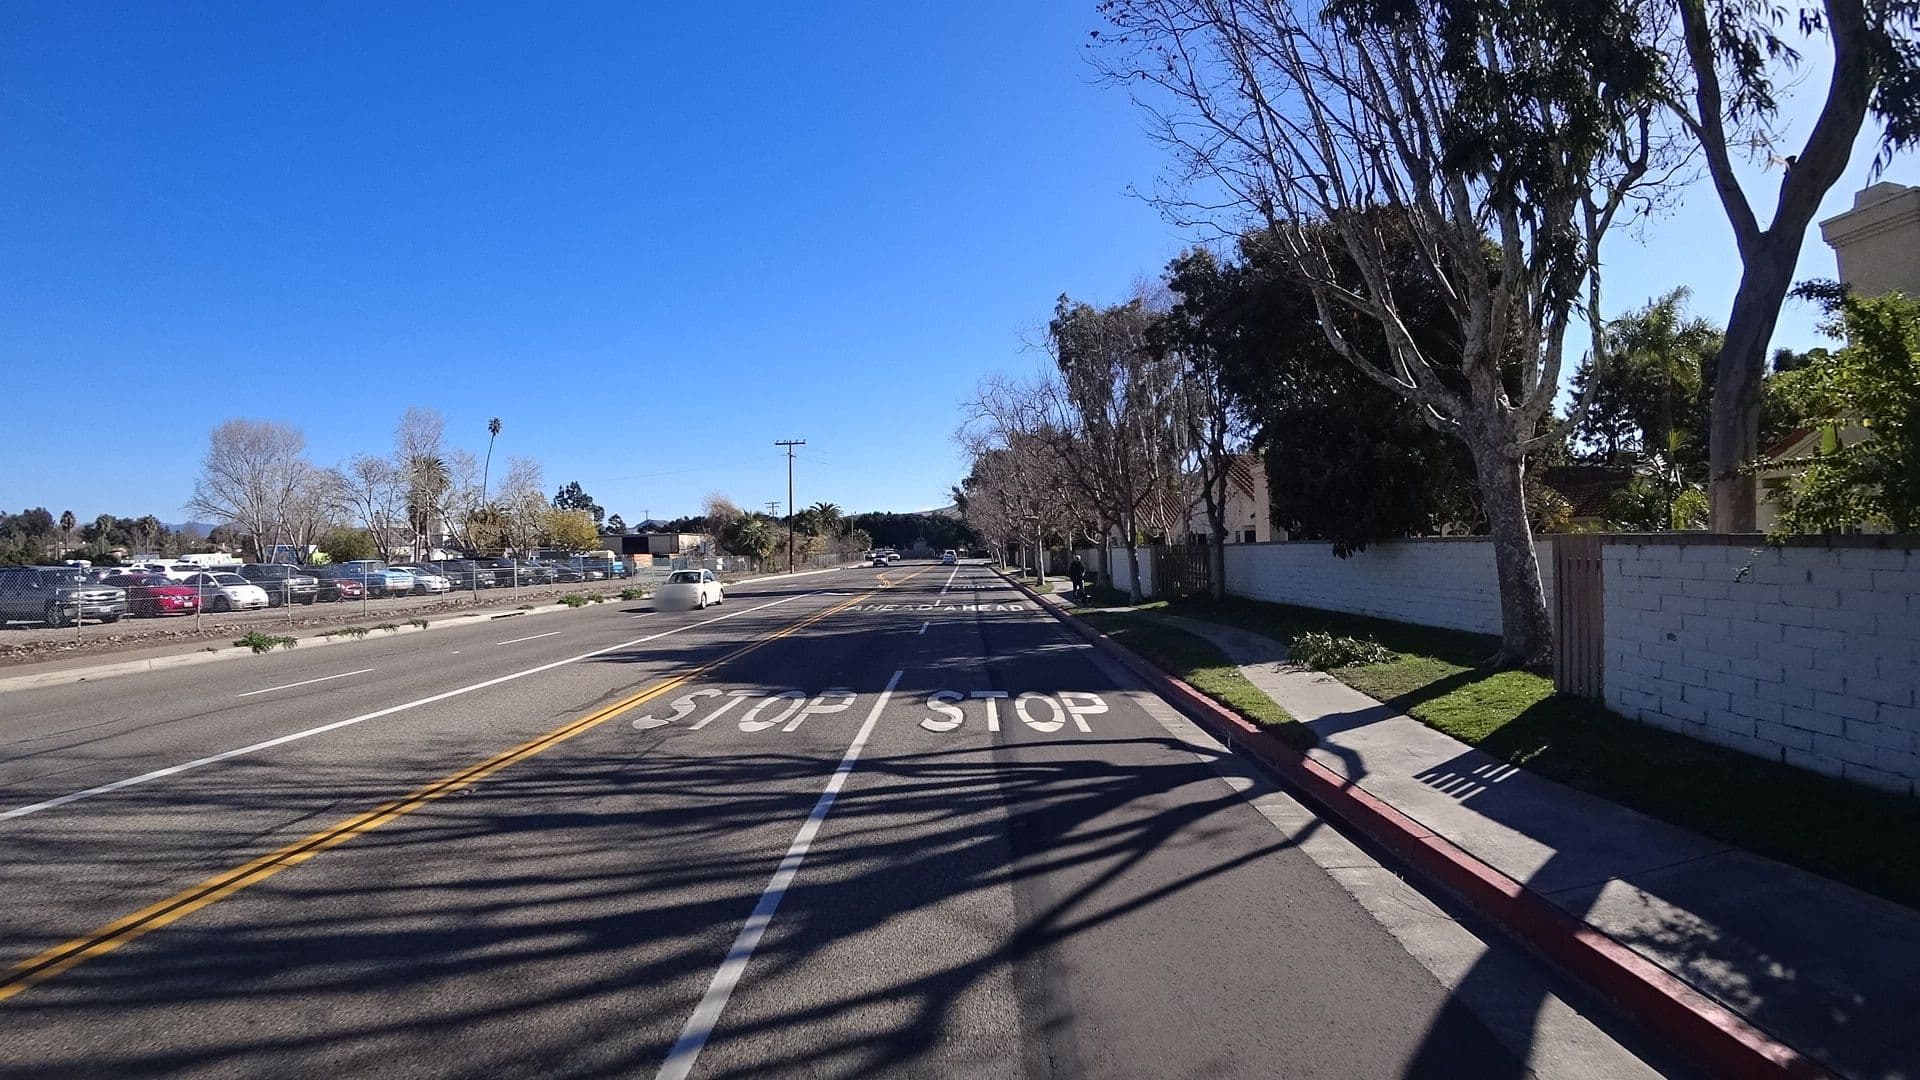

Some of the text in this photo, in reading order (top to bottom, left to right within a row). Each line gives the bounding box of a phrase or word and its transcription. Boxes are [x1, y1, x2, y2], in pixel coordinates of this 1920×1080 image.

[943, 604, 1025, 612] AHEAD
[632, 688, 858, 732] STOP
[919, 690, 1110, 733] STOP
